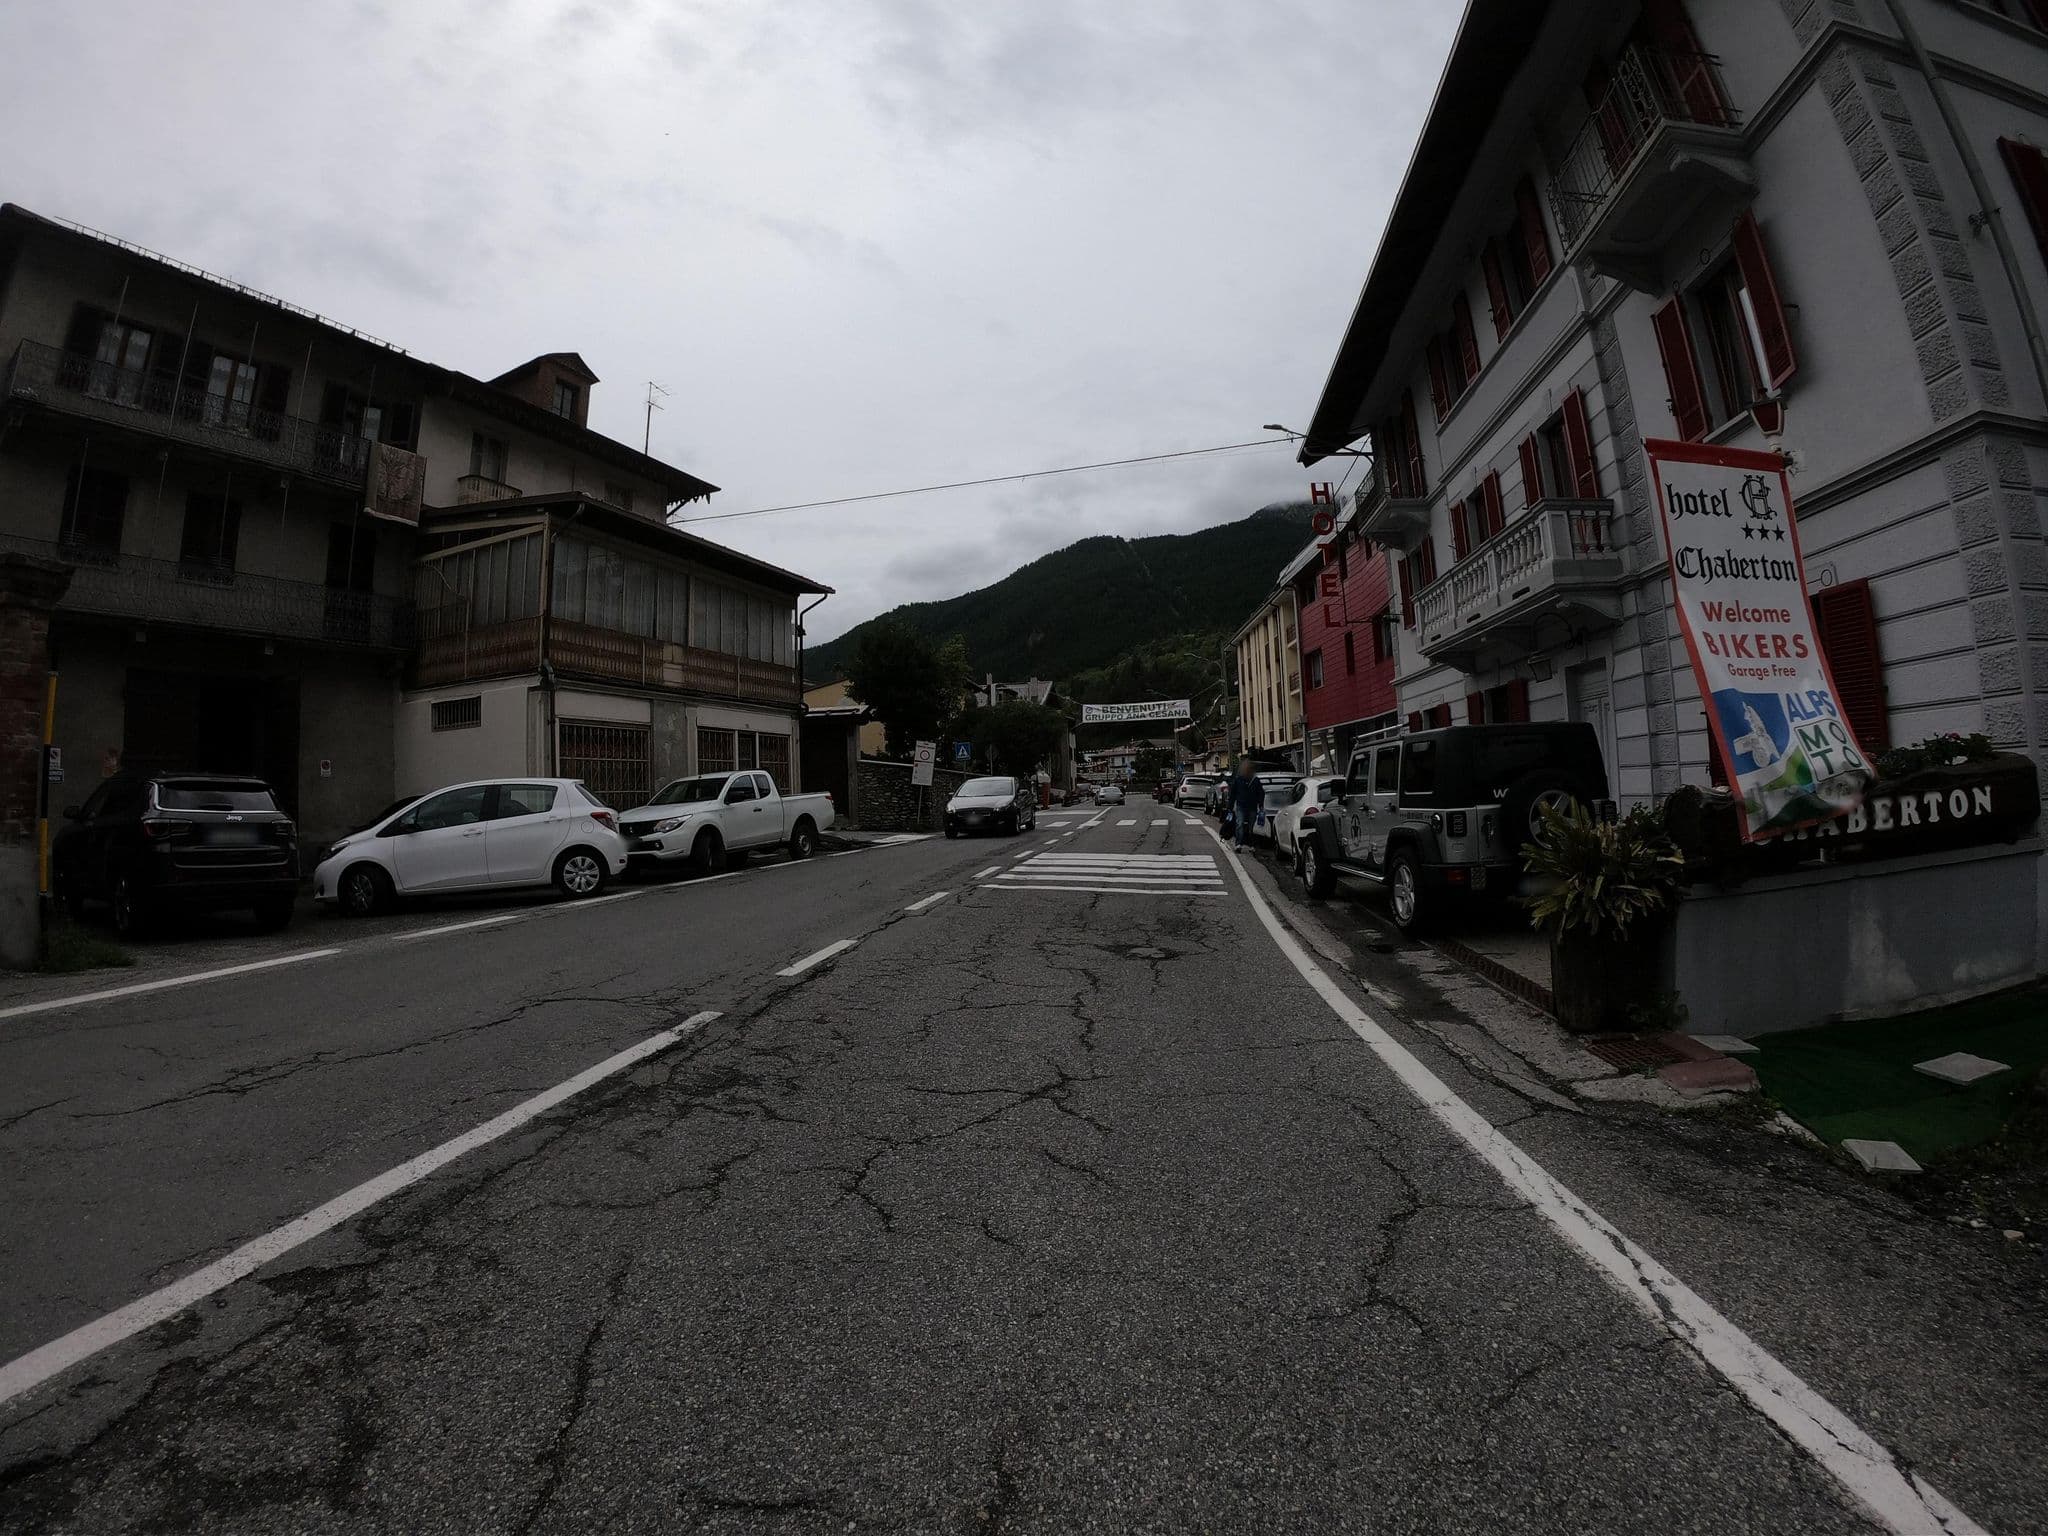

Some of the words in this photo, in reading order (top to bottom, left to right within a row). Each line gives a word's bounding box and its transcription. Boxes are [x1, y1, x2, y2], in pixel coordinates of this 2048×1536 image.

[1665, 483, 1732, 520] hotel
[1311, 482, 1341, 628] HOTEL
[1676, 546, 1797, 584] Chaberton
[1701, 600, 1791, 623] Welcome
[1703, 631, 1809, 658] BIKERS
[1728, 663, 1769, 680] Garage
[1771, 664, 1796, 676] Free
[1085, 713, 1123, 722] GRUPPO
[1102, 703, 1166, 714] BENVENUTI
[1786, 690, 1837, 722] ALPS
